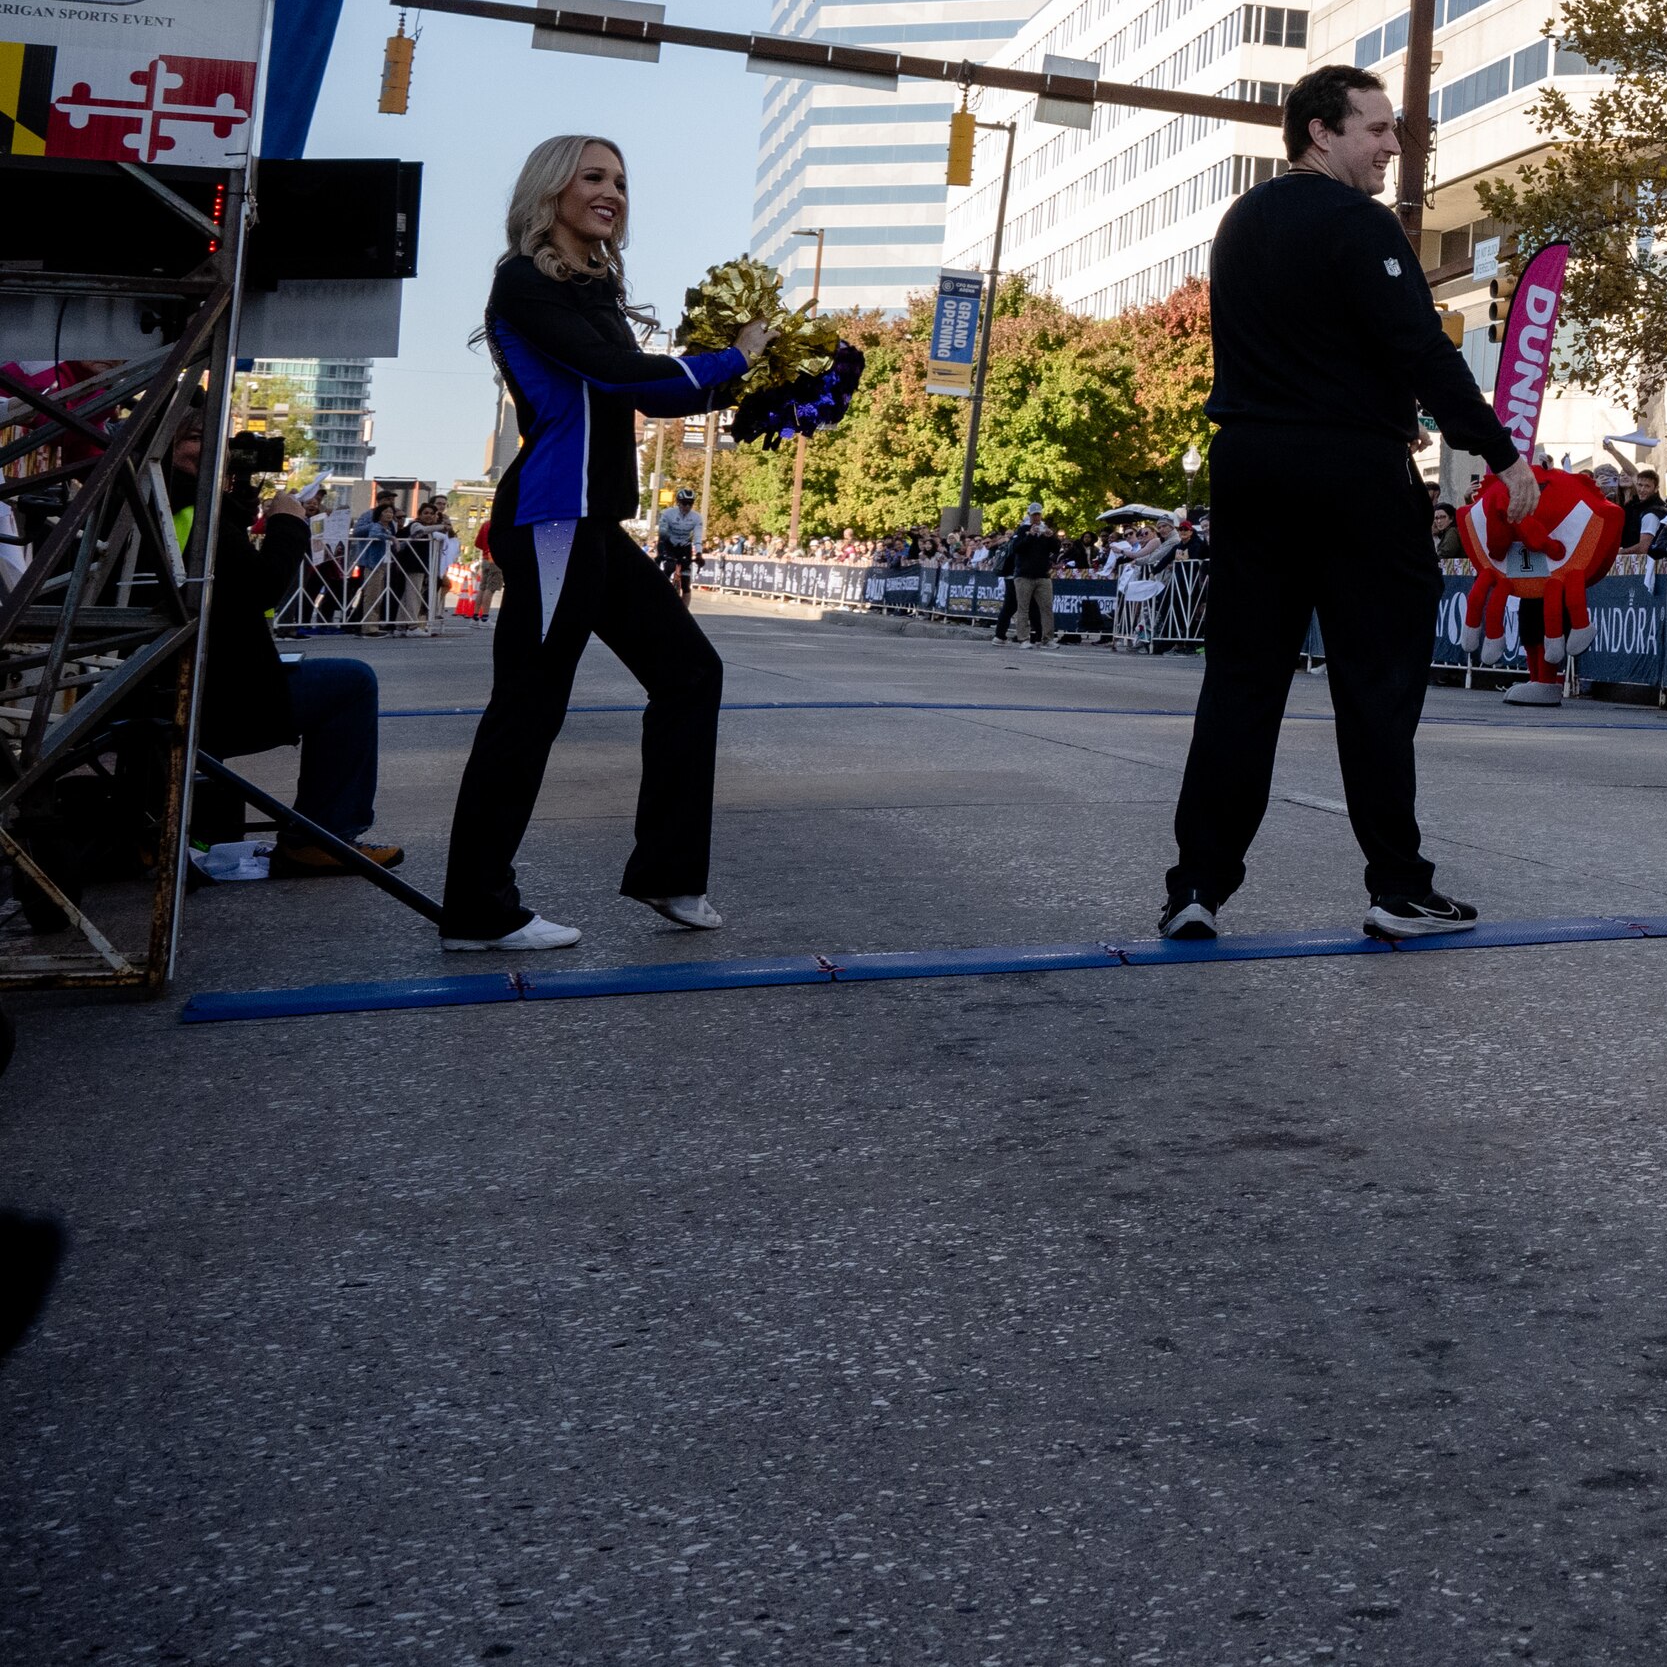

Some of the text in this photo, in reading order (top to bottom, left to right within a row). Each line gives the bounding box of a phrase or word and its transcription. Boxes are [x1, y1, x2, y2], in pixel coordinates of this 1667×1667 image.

[58, 8, 119, 24] SPORTS
[122, 14, 176, 28] EVENT
[937, 299, 957, 358] OPENING
[953, 301, 972, 349] GRAND
[1518, 547, 1534, 572] 1
